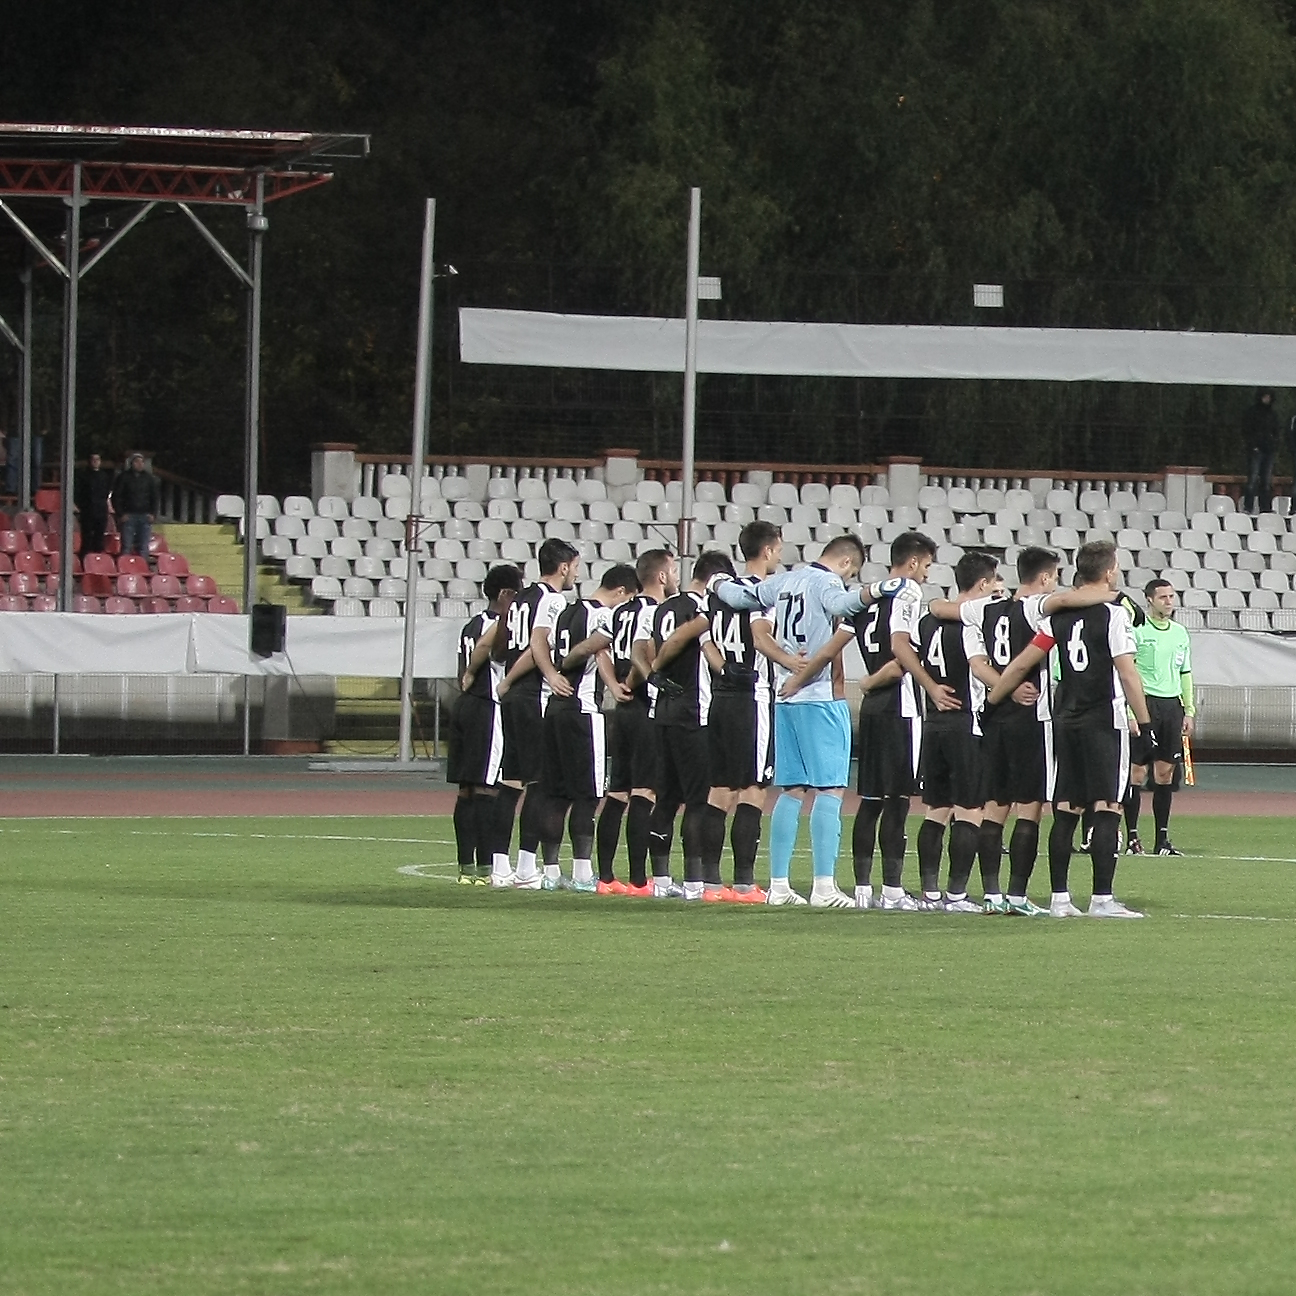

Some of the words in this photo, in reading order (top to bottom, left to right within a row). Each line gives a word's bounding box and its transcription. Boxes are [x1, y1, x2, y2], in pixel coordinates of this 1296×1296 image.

[506, 601, 531, 650] 90
[711, 611, 745, 663] 44
[778, 591, 807, 643] 72
[864, 603, 880, 653] 2
[993, 615, 1011, 666] 8
[927, 626, 947, 677] 4
[1067, 619, 1089, 672] 6
